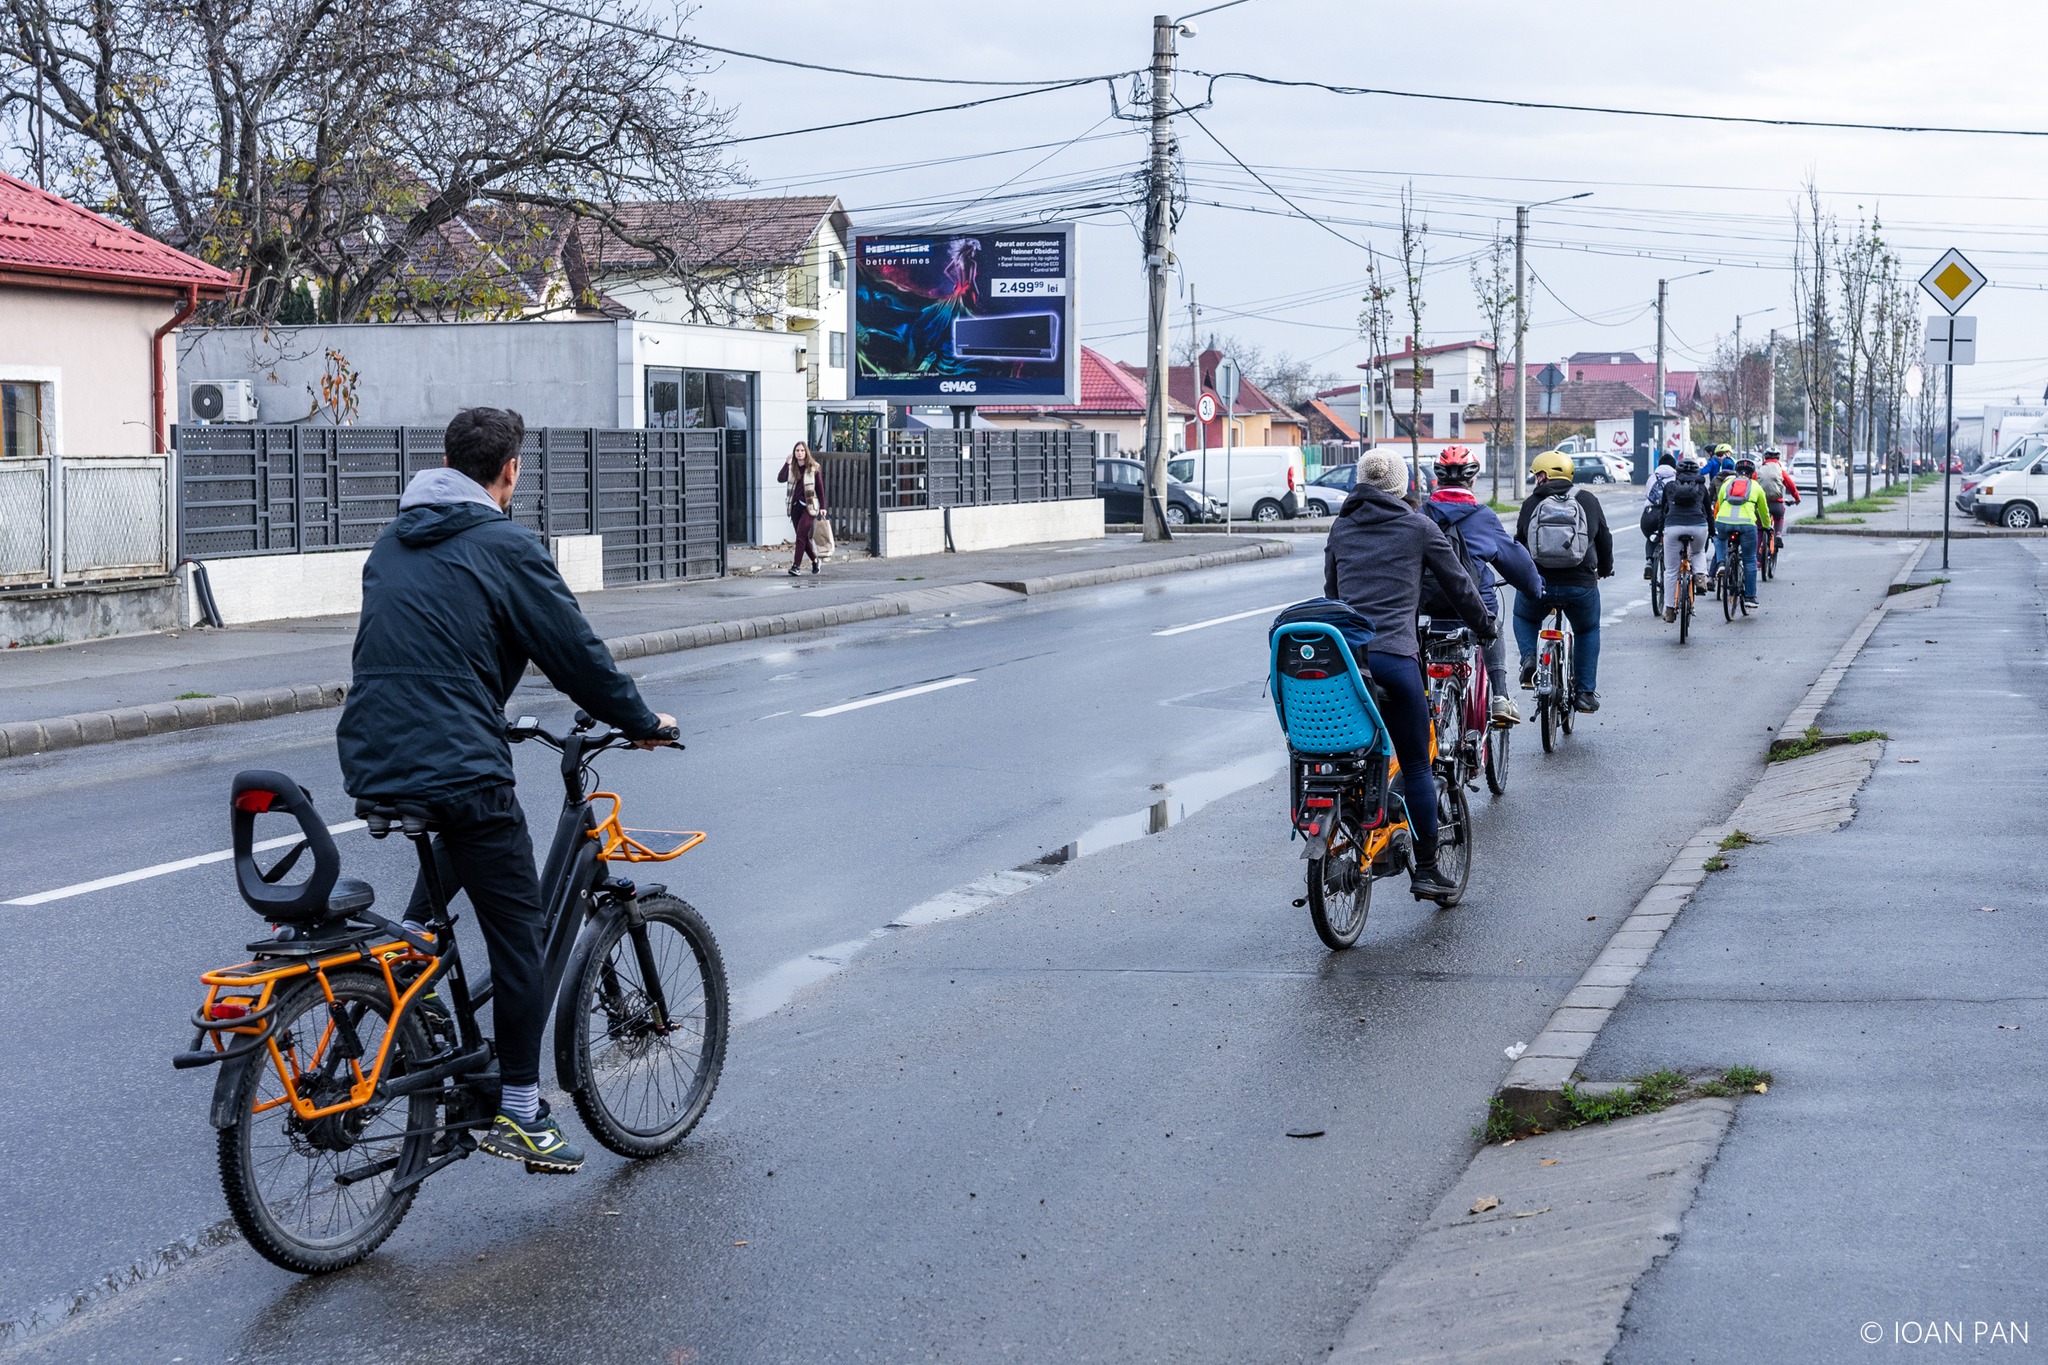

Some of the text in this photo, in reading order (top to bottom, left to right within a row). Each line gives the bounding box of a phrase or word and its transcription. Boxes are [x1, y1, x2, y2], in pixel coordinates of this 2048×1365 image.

[865, 244, 930, 254] HEINNER
[865, 257, 930, 266] better times
[1047, 284, 1058, 293] lei
[940, 381, 977, 393] eMAG
